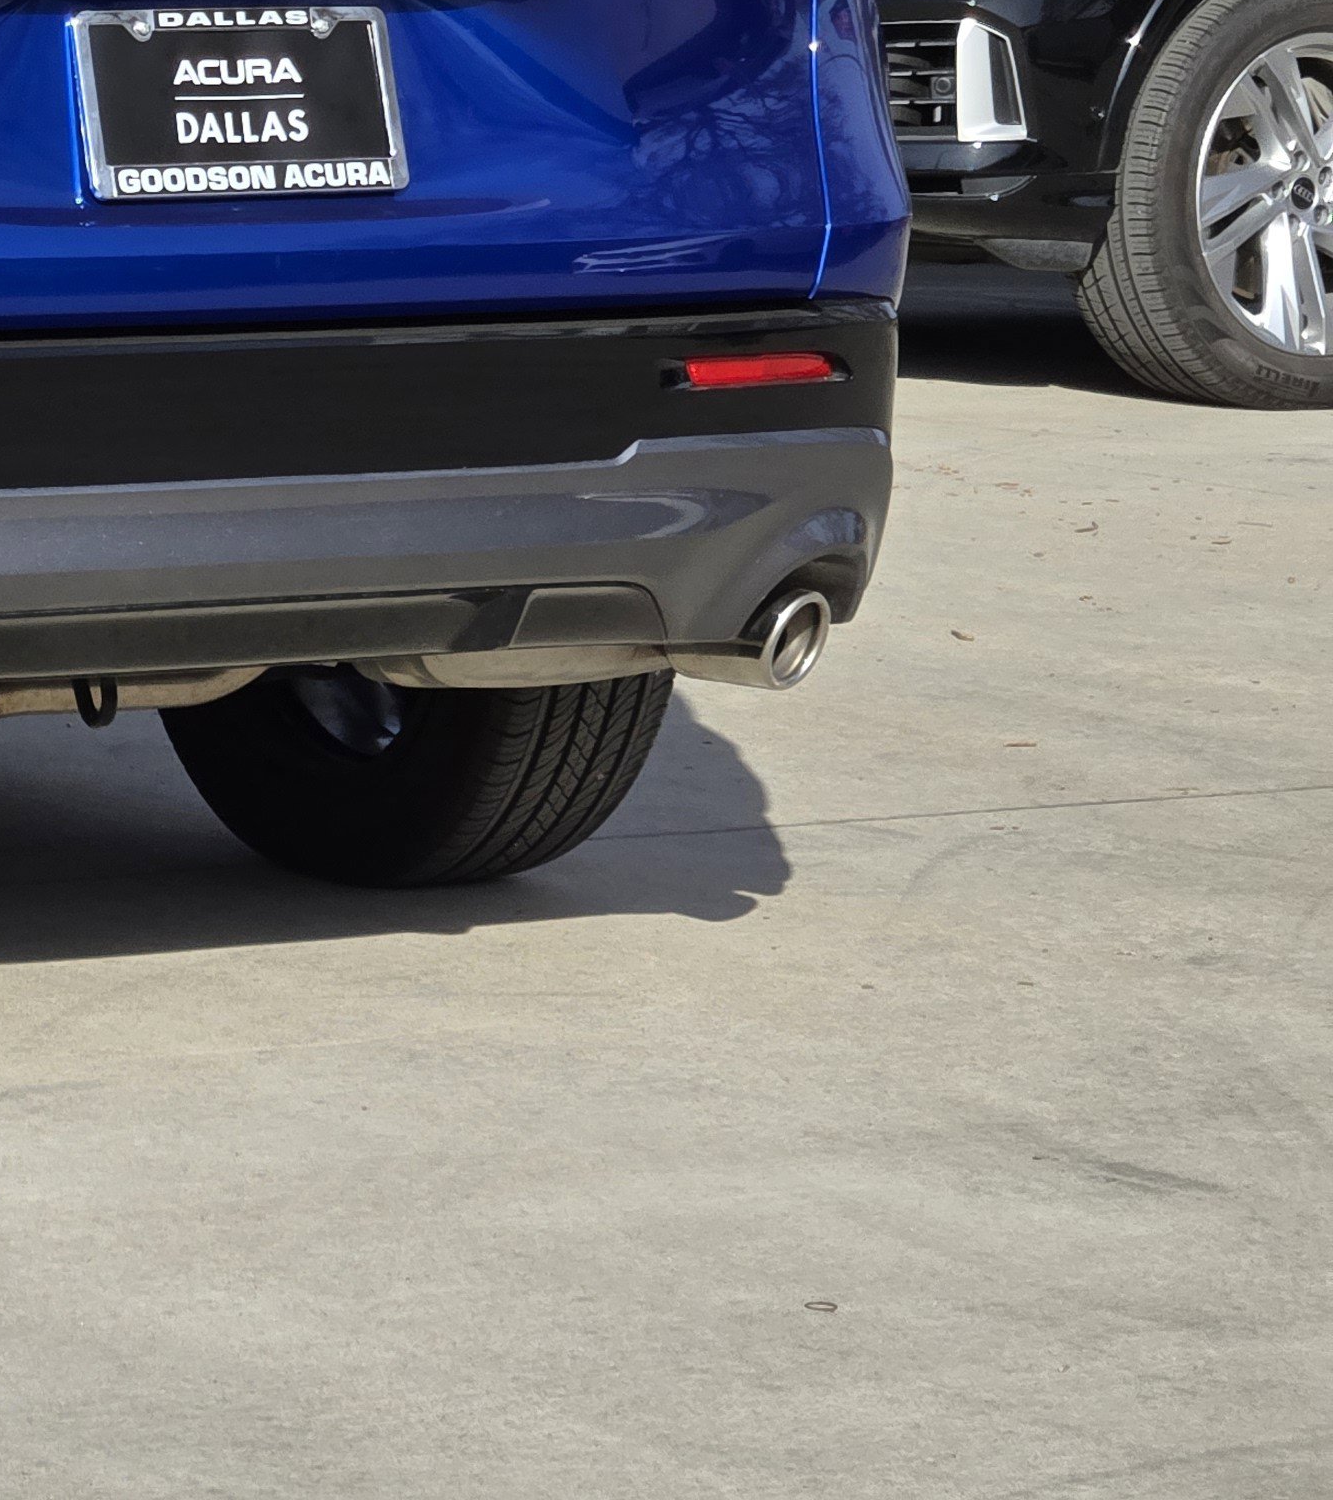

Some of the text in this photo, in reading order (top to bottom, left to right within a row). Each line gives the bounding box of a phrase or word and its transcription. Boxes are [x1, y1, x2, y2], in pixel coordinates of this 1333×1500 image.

[158, 10, 309, 28] DALLAS
[173, 57, 303, 86] ACURA
[175, 109, 309, 144] DALLAS
[118, 160, 391, 194] GOODSON ACURA
